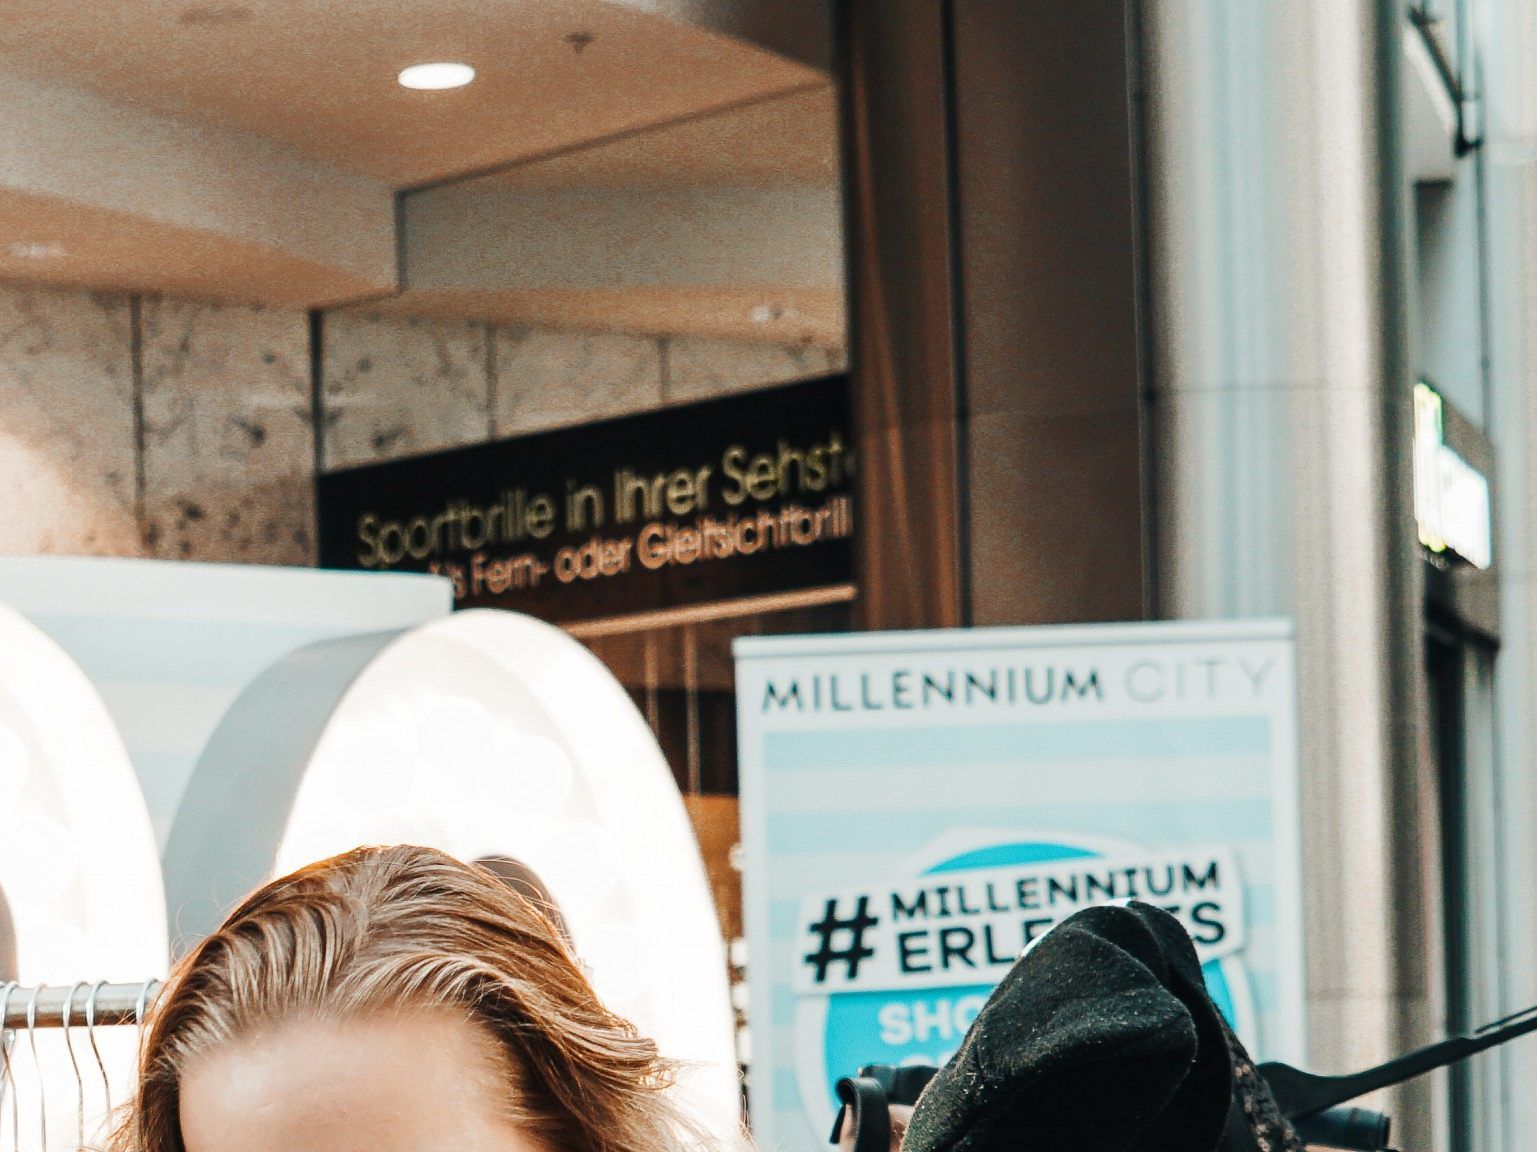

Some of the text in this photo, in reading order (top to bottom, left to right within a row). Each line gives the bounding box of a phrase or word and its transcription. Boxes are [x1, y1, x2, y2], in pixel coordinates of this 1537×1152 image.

[358, 488, 557, 567] Sportbrille
[565, 478, 603, 532] in
[615, 465, 710, 522] Ihrer
[554, 537, 632, 581] oder
[762, 657, 1276, 713] MILLENNIUM CITY
[891, 860, 1220, 920] MILLENNIUM
[878, 995, 988, 1046] SHO
